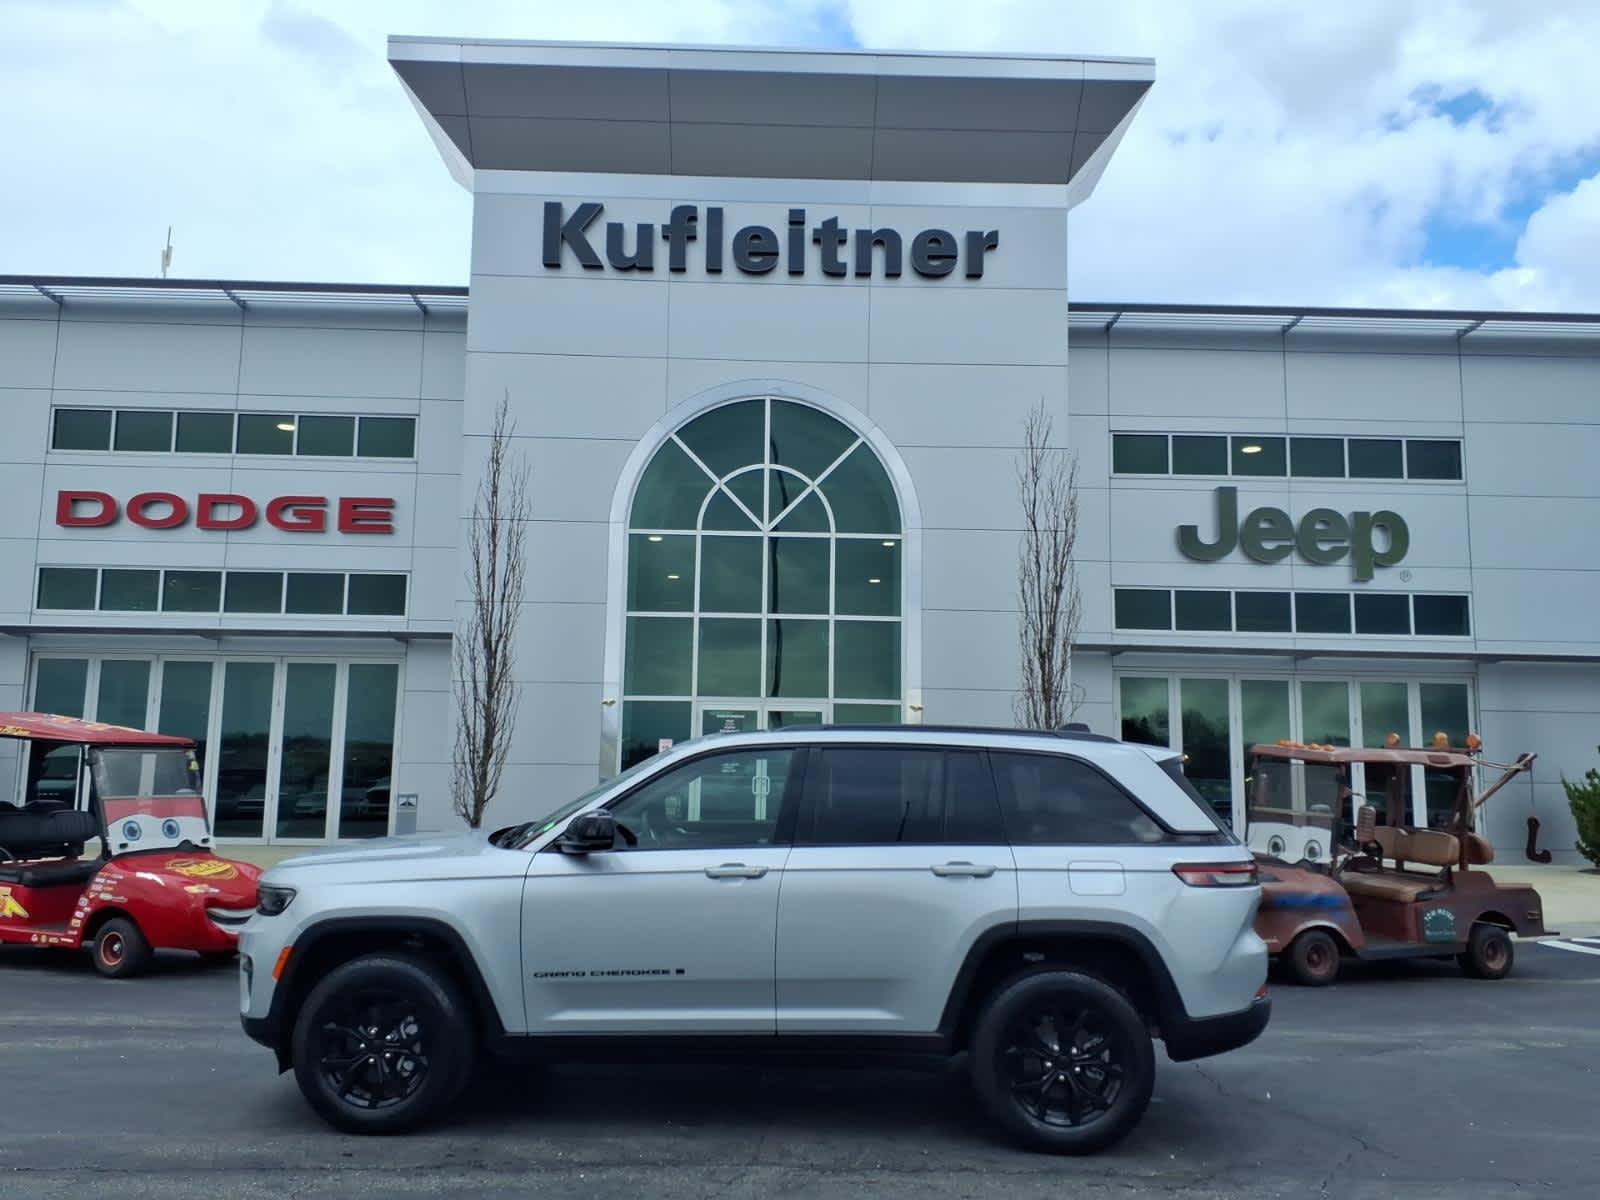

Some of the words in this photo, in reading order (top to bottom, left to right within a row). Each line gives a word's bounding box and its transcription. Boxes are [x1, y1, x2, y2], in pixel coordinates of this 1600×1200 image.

[542, 201, 999, 279] Kufleitner
[56, 490, 395, 534] DODGE
[1177, 486, 1410, 582] Jeep
[533, 970, 586, 978] GRAND
[590, 969, 670, 977] CHEROKEE
